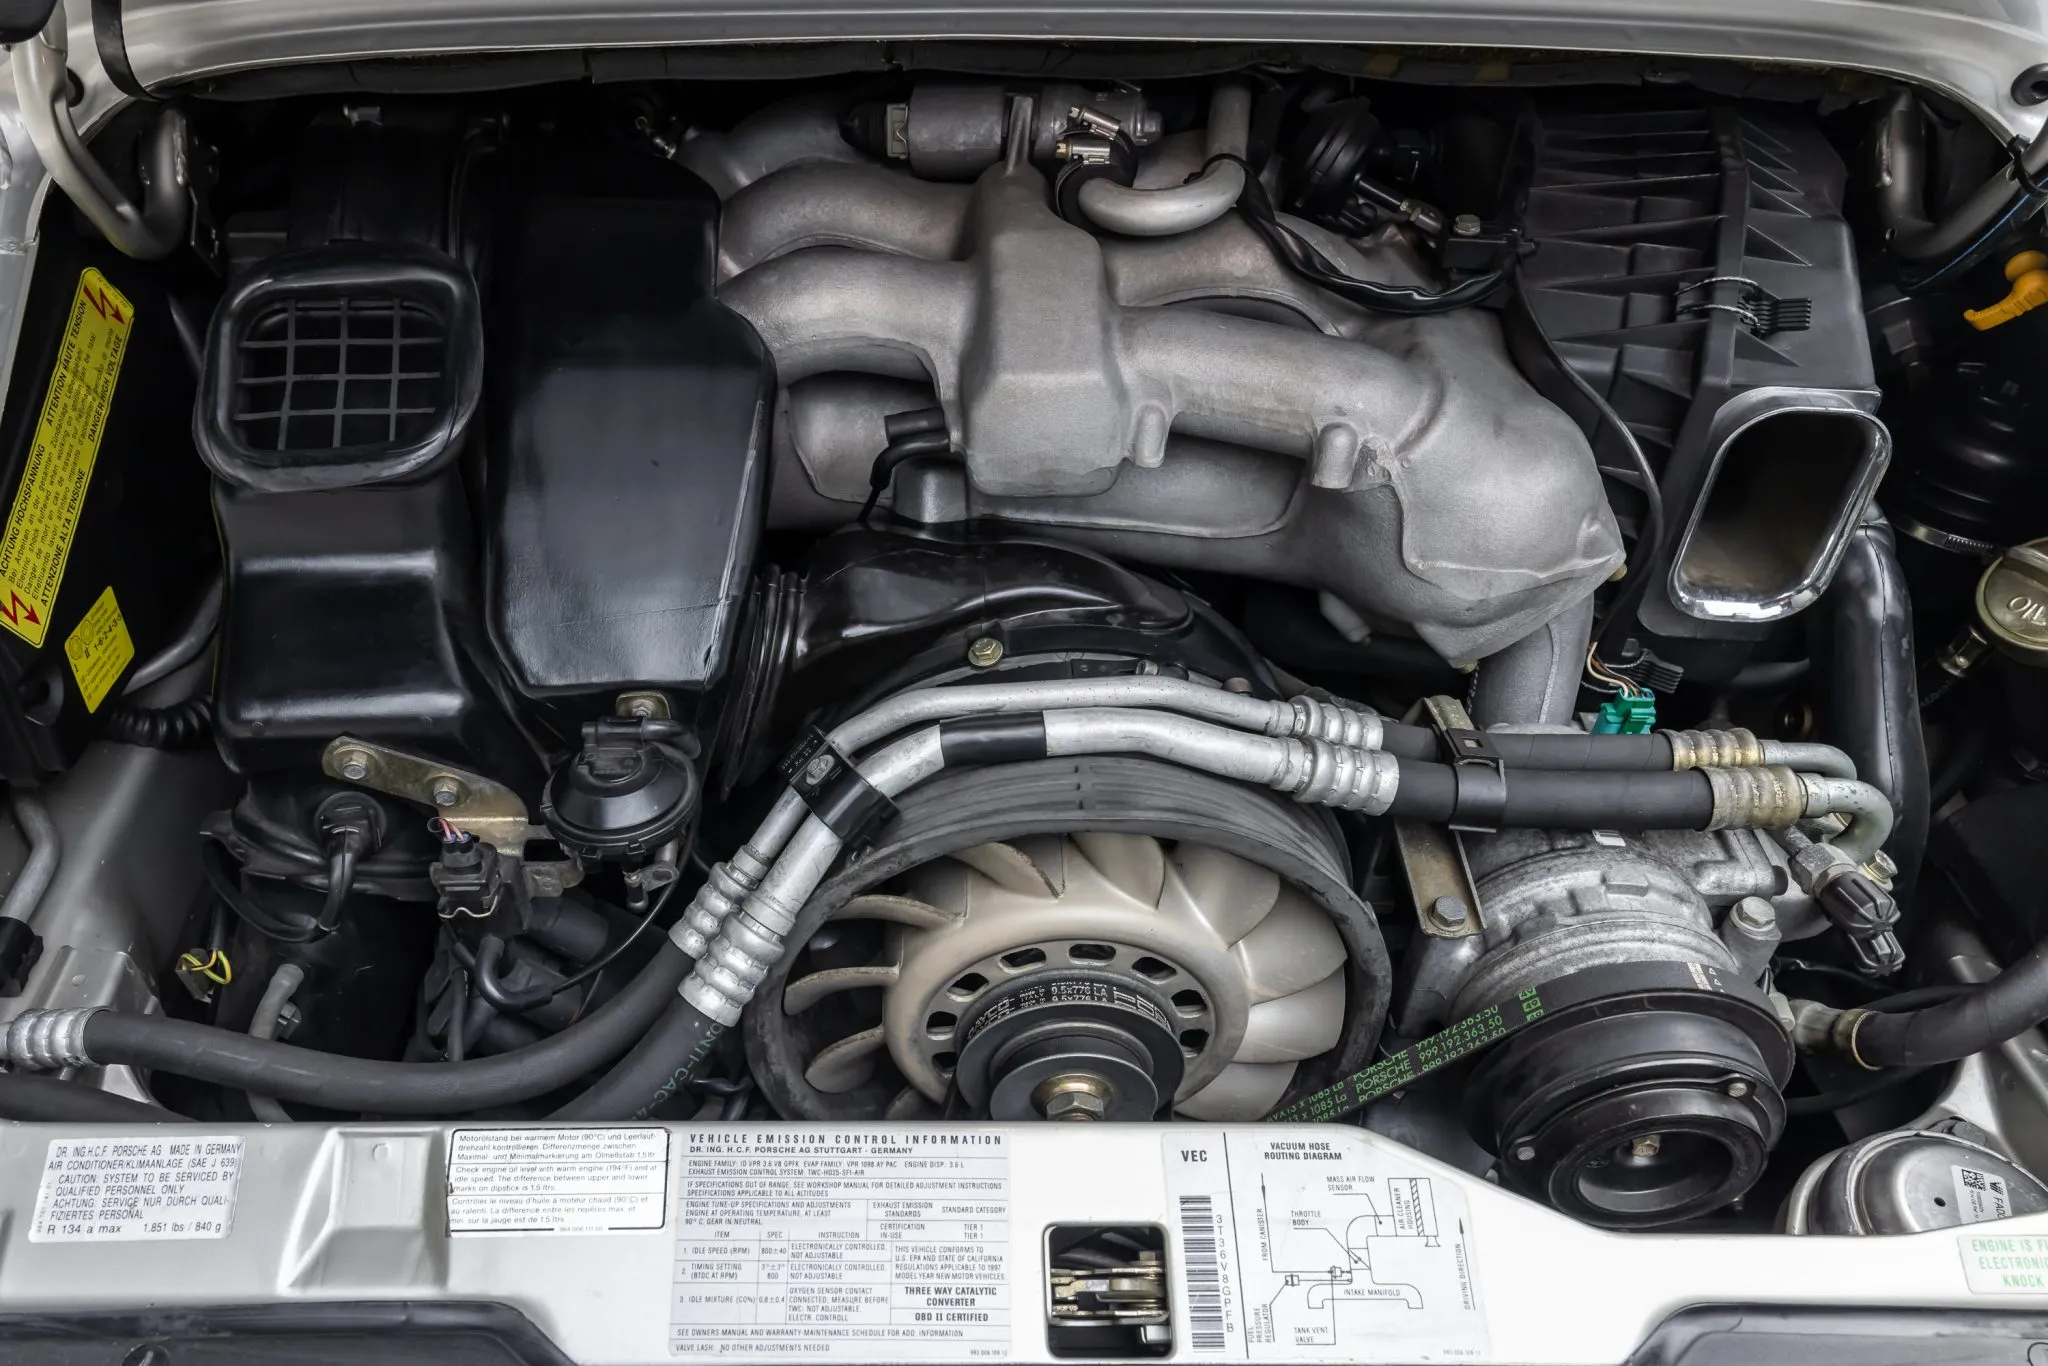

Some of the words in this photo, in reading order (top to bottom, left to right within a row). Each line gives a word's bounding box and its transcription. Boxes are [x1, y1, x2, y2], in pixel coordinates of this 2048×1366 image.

[46, 369, 67, 426] ATTENTION
[61, 340, 76, 371] HAUTE
[70, 299, 87, 338] TENSION
[88, 401, 105, 442] DANGER
[99, 378, 111, 401] HIGH
[105, 335, 122, 376] VOLTAGE
[0, 526, 20, 577] ACHTUNG
[15, 443, 45, 526] HOCHSPANNUNG
[40, 544, 64, 606] ATTENZIONE
[59, 517, 72, 543] ALTA
[67, 468, 85, 515] TENSIONE
[2007, 596, 2047, 626] OIL
[1355, 1059, 1411, 1093] PORSCHE
[1419, 1015, 1502, 1062] 999.192.363.50
[690, 1134, 747, 1143] VEHICLE
[757, 1134, 825, 1144] EMISSION
[835, 1135, 896, 1144] CONTROL
[906, 1135, 1001, 1145] INFORMATION
[1309, 1142, 1330, 1150] HOSE
[112, 1145, 148, 1157] PORSCHE
[151, 1145, 161, 1156] AG
[170, 1144, 190, 1155] MADE
[194, 1144, 202, 1155] IN
[205, 1143, 241, 1155] GERMANY
[1181, 1150, 1208, 1162] VEC
[1265, 1152, 1300, 1160] ROUTING
[1304, 1152, 1342, 1160] DIAGRAM
[48, 1161, 62, 1170] AIR
[67, 1159, 183, 1170] CONDITIONER/KLIMAANLAGE
[188, 1158, 207, 1169] (SAE
[220, 1158, 238, 1167] 639)
[103, 1174, 138, 1183] SYSTEM
[144, 1173, 155, 1182] TO
[159, 1173, 170, 1182] BE
[175, 1172, 218, 1181] SERVICED
[223, 1171, 235, 1180] BY
[56, 1187, 100, 1196] QUALIFIED
[105, 1186, 156, 1195] PERSONNEL
[161, 1185, 185, 1194] ONLY
[101, 1198, 139, 1207] SERVICE
[144, 1197, 162, 1206] NUR
[167, 1196, 196, 1206] DURCH
[1394, 1188, 1403, 1216] CLEANER
[51, 1211, 94, 1221] FIZIERTES
[99, 1210, 144, 1220] PERSONAL
[1404, 1200, 1414, 1229] HOUSING
[48, 1225, 56, 1234] R
[62, 1225, 80, 1234] 134
[99, 1225, 122, 1233] max
[172, 1223, 185, 1231] lbs
[195, 1222, 212, 1231] 840
[215, 1224, 221, 1233] g
[1257, 1209, 1266, 1239] CANISTER
[1972, 1239, 2016, 1251] ENGINE
[2021, 1239, 2032, 1252] IS
[1455, 1244, 1465, 1278] DIRECTION
[2003, 1274, 2044, 1287] KNOCK
[905, 1287, 931, 1295] THREE
[934, 1287, 952, 1295] WAY
[956, 1287, 997, 1295] CATALYTIC
[1460, 1281, 1471, 1309] DRIVING
[927, 1298, 975, 1306] CONVERTER
[915, 1313, 932, 1321] OBD
[936, 1313, 943, 1321] II
[946, 1313, 988, 1322] CERTIFIED
[1262, 1304, 1271, 1343] REGULATOR
[1254, 1308, 1263, 1342] PRESSURE
